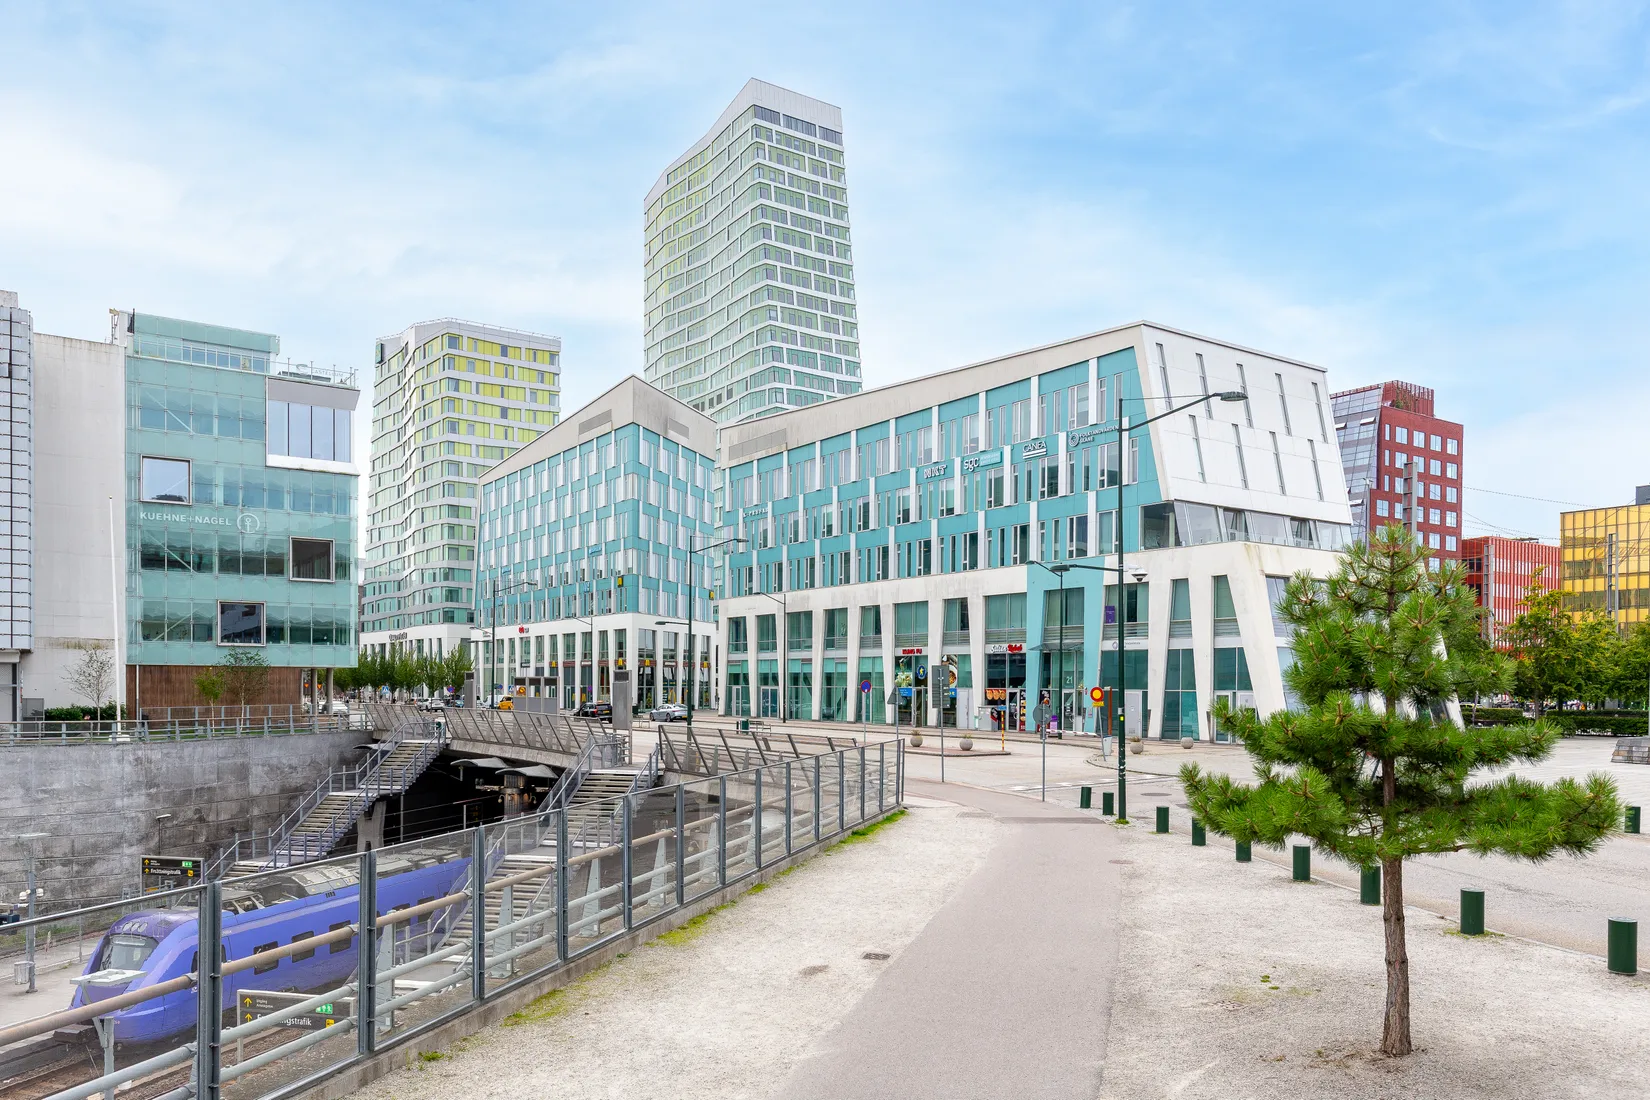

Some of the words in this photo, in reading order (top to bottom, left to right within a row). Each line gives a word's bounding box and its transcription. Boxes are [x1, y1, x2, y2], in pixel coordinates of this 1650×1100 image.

[924, 465, 947, 478] NKT
[964, 458, 979, 472] sgc
[140, 511, 232, 526] KUEHNE+NAGEL
[1066, 676, 1073, 684] 21
